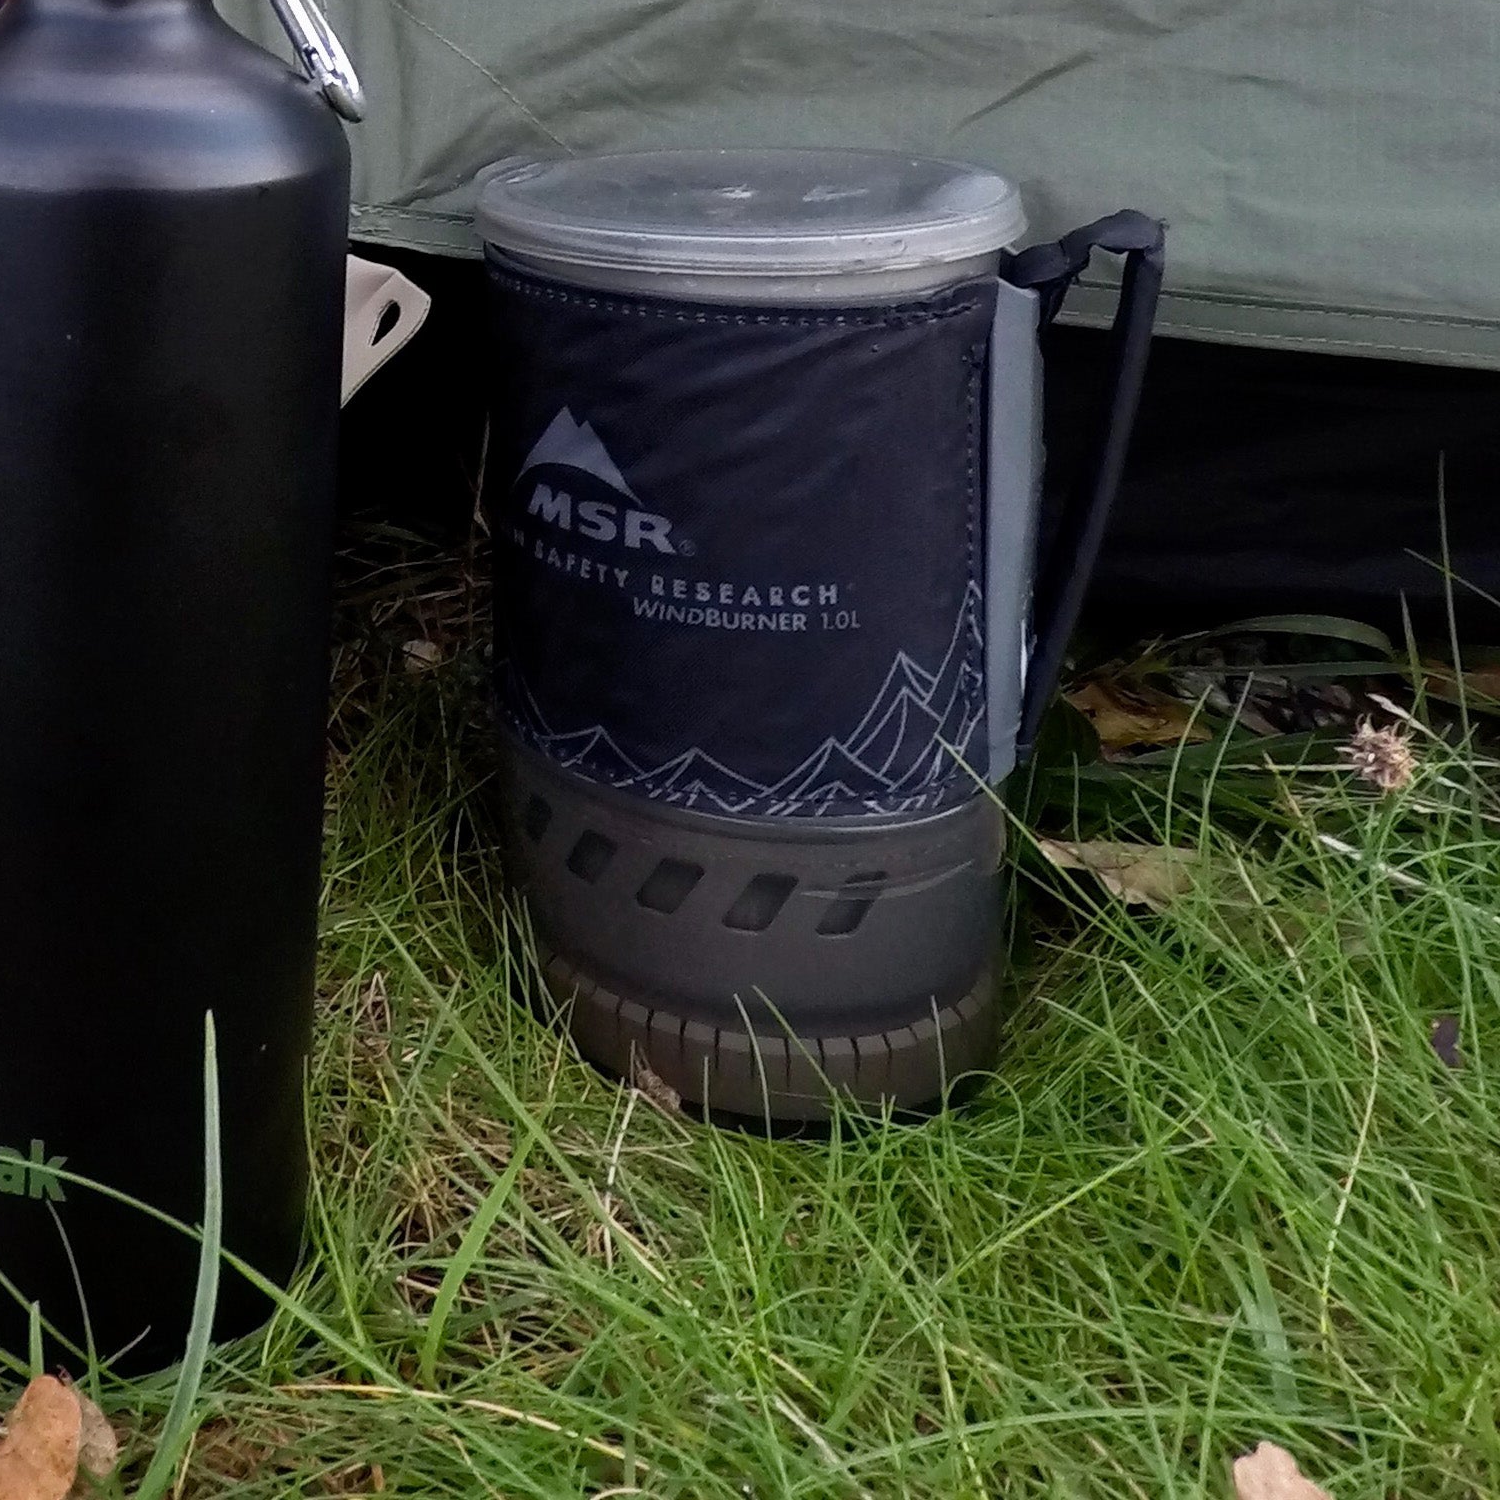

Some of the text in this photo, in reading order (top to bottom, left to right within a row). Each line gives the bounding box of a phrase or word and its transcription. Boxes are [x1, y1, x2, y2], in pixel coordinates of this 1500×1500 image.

[533, 541, 840, 606] SAFETY RESEARCH
[632, 596, 861, 632] WINDBURNER 1.0L
